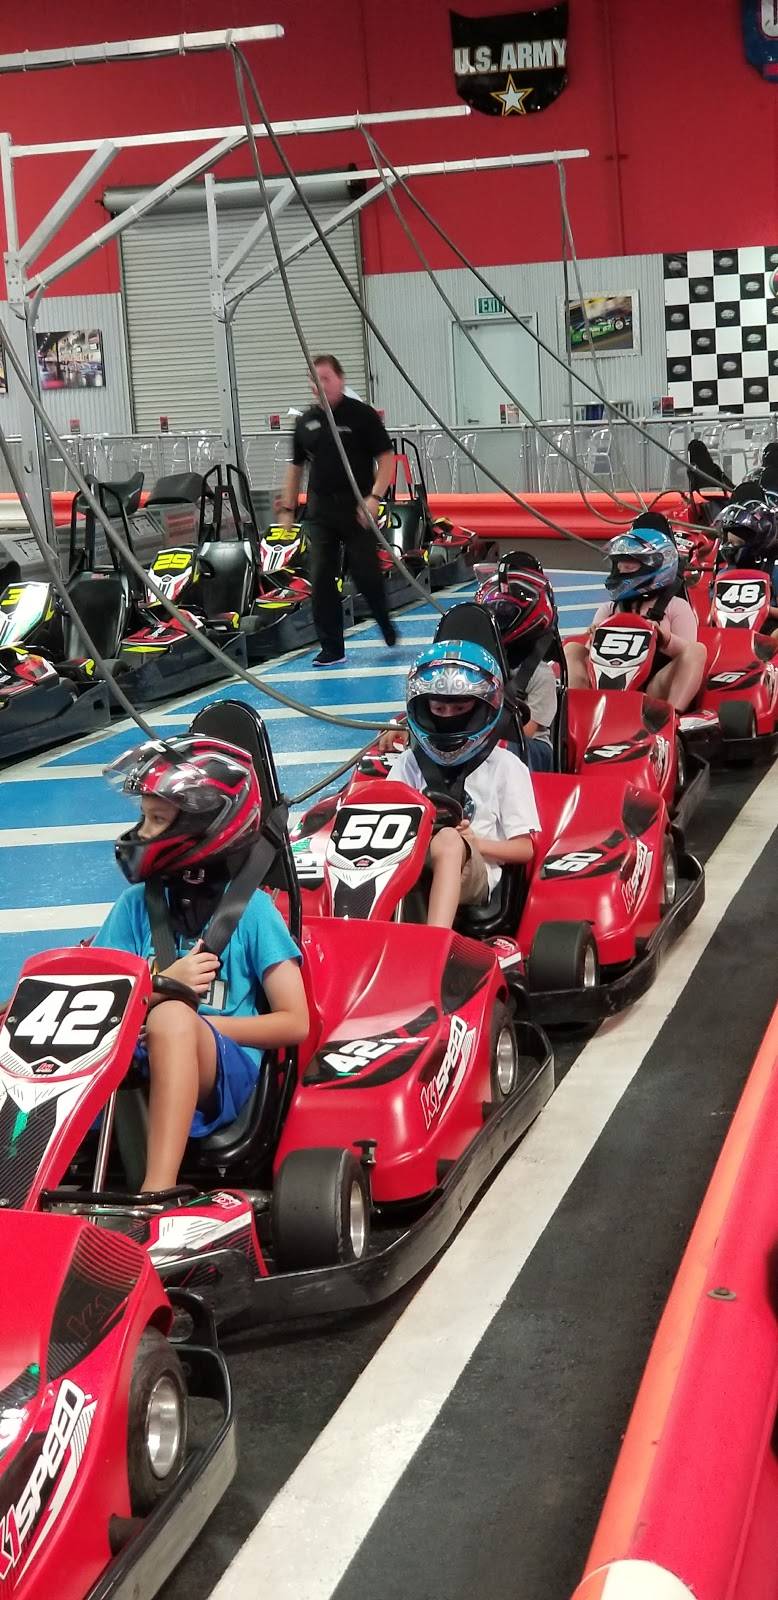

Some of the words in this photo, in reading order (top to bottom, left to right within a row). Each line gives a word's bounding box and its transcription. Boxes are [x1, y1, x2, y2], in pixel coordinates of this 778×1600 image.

[453, 46, 497, 75] U.S.
[501, 39, 566, 70] ARMY
[152, 553, 192, 571] 29
[721, 584, 761, 604] 48
[599, 633, 646, 657] 51
[337, 814, 412, 850] 50
[544, 852, 603, 872] 50
[14, 990, 116, 1045] 42
[322, 1040, 397, 1073] 42
